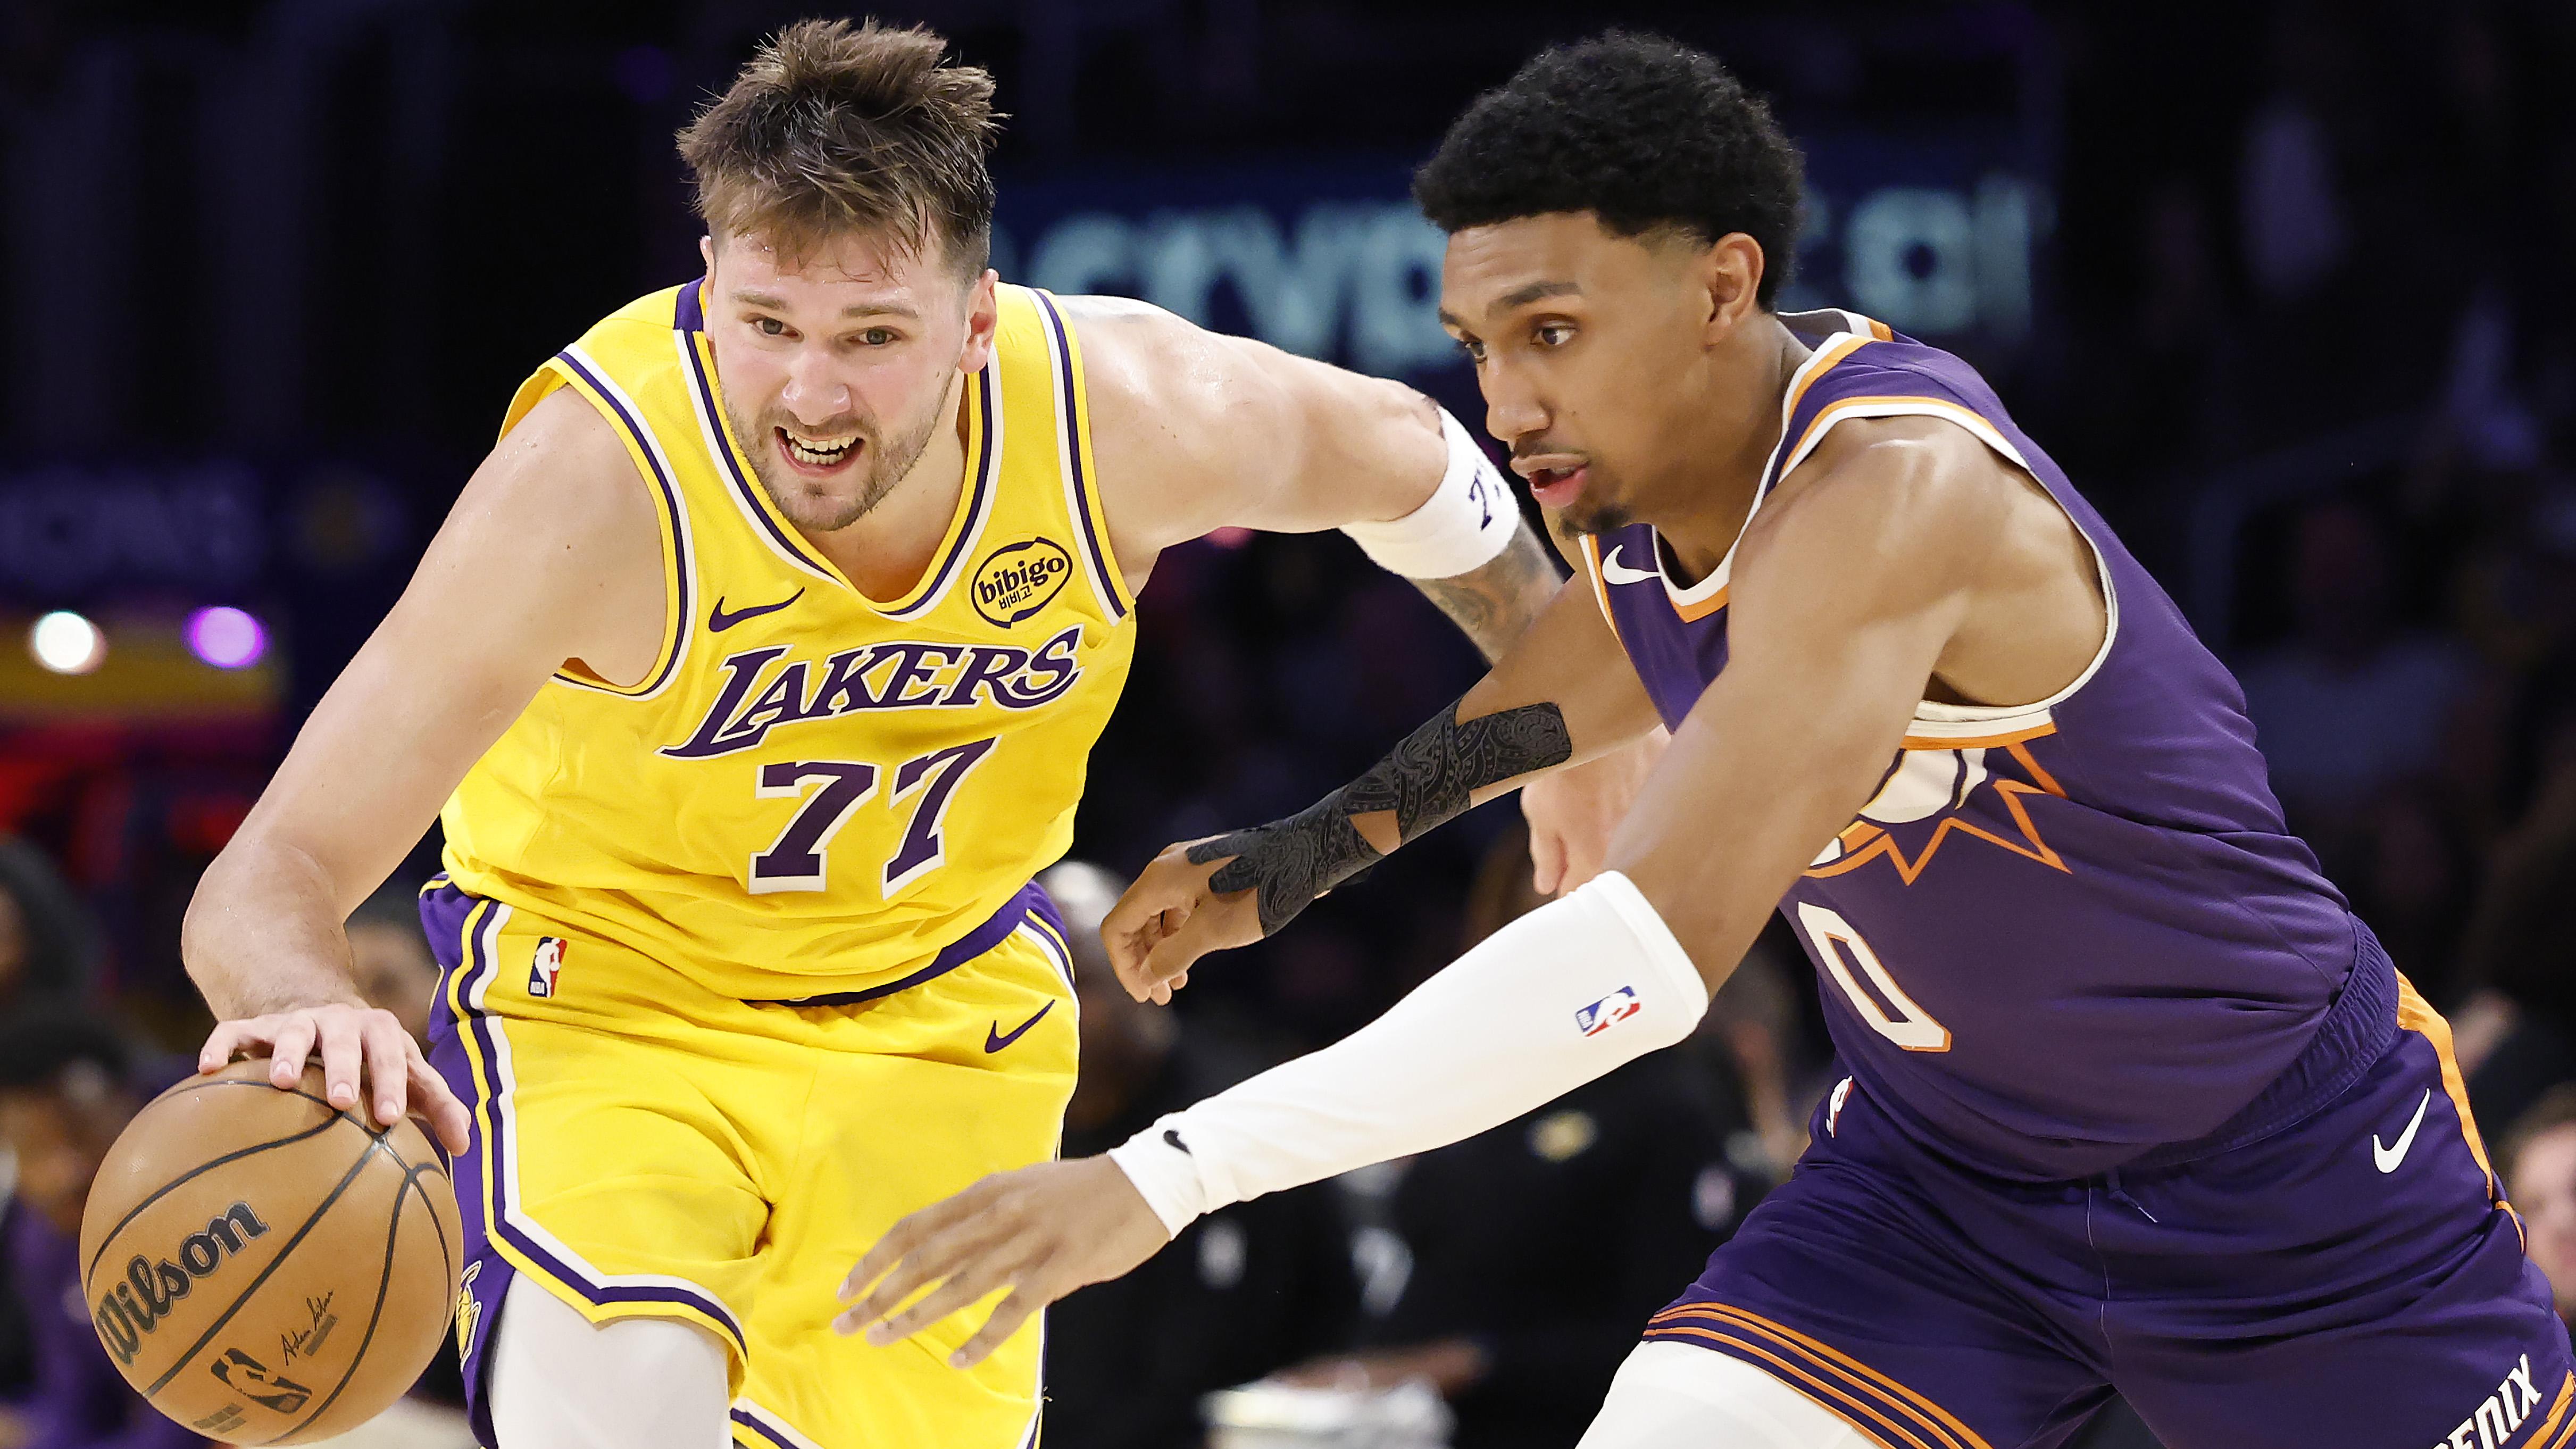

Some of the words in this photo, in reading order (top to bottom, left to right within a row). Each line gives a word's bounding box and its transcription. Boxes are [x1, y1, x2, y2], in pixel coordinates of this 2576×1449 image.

[978, 556, 1065, 604] bibigo
[998, 585, 1032, 610] 비비고
[654, 623, 1087, 759] LAKERS
[748, 735, 1001, 900] 77
[1798, 901, 1952, 1052] 0
[95, 1201, 270, 1368] Wilson
